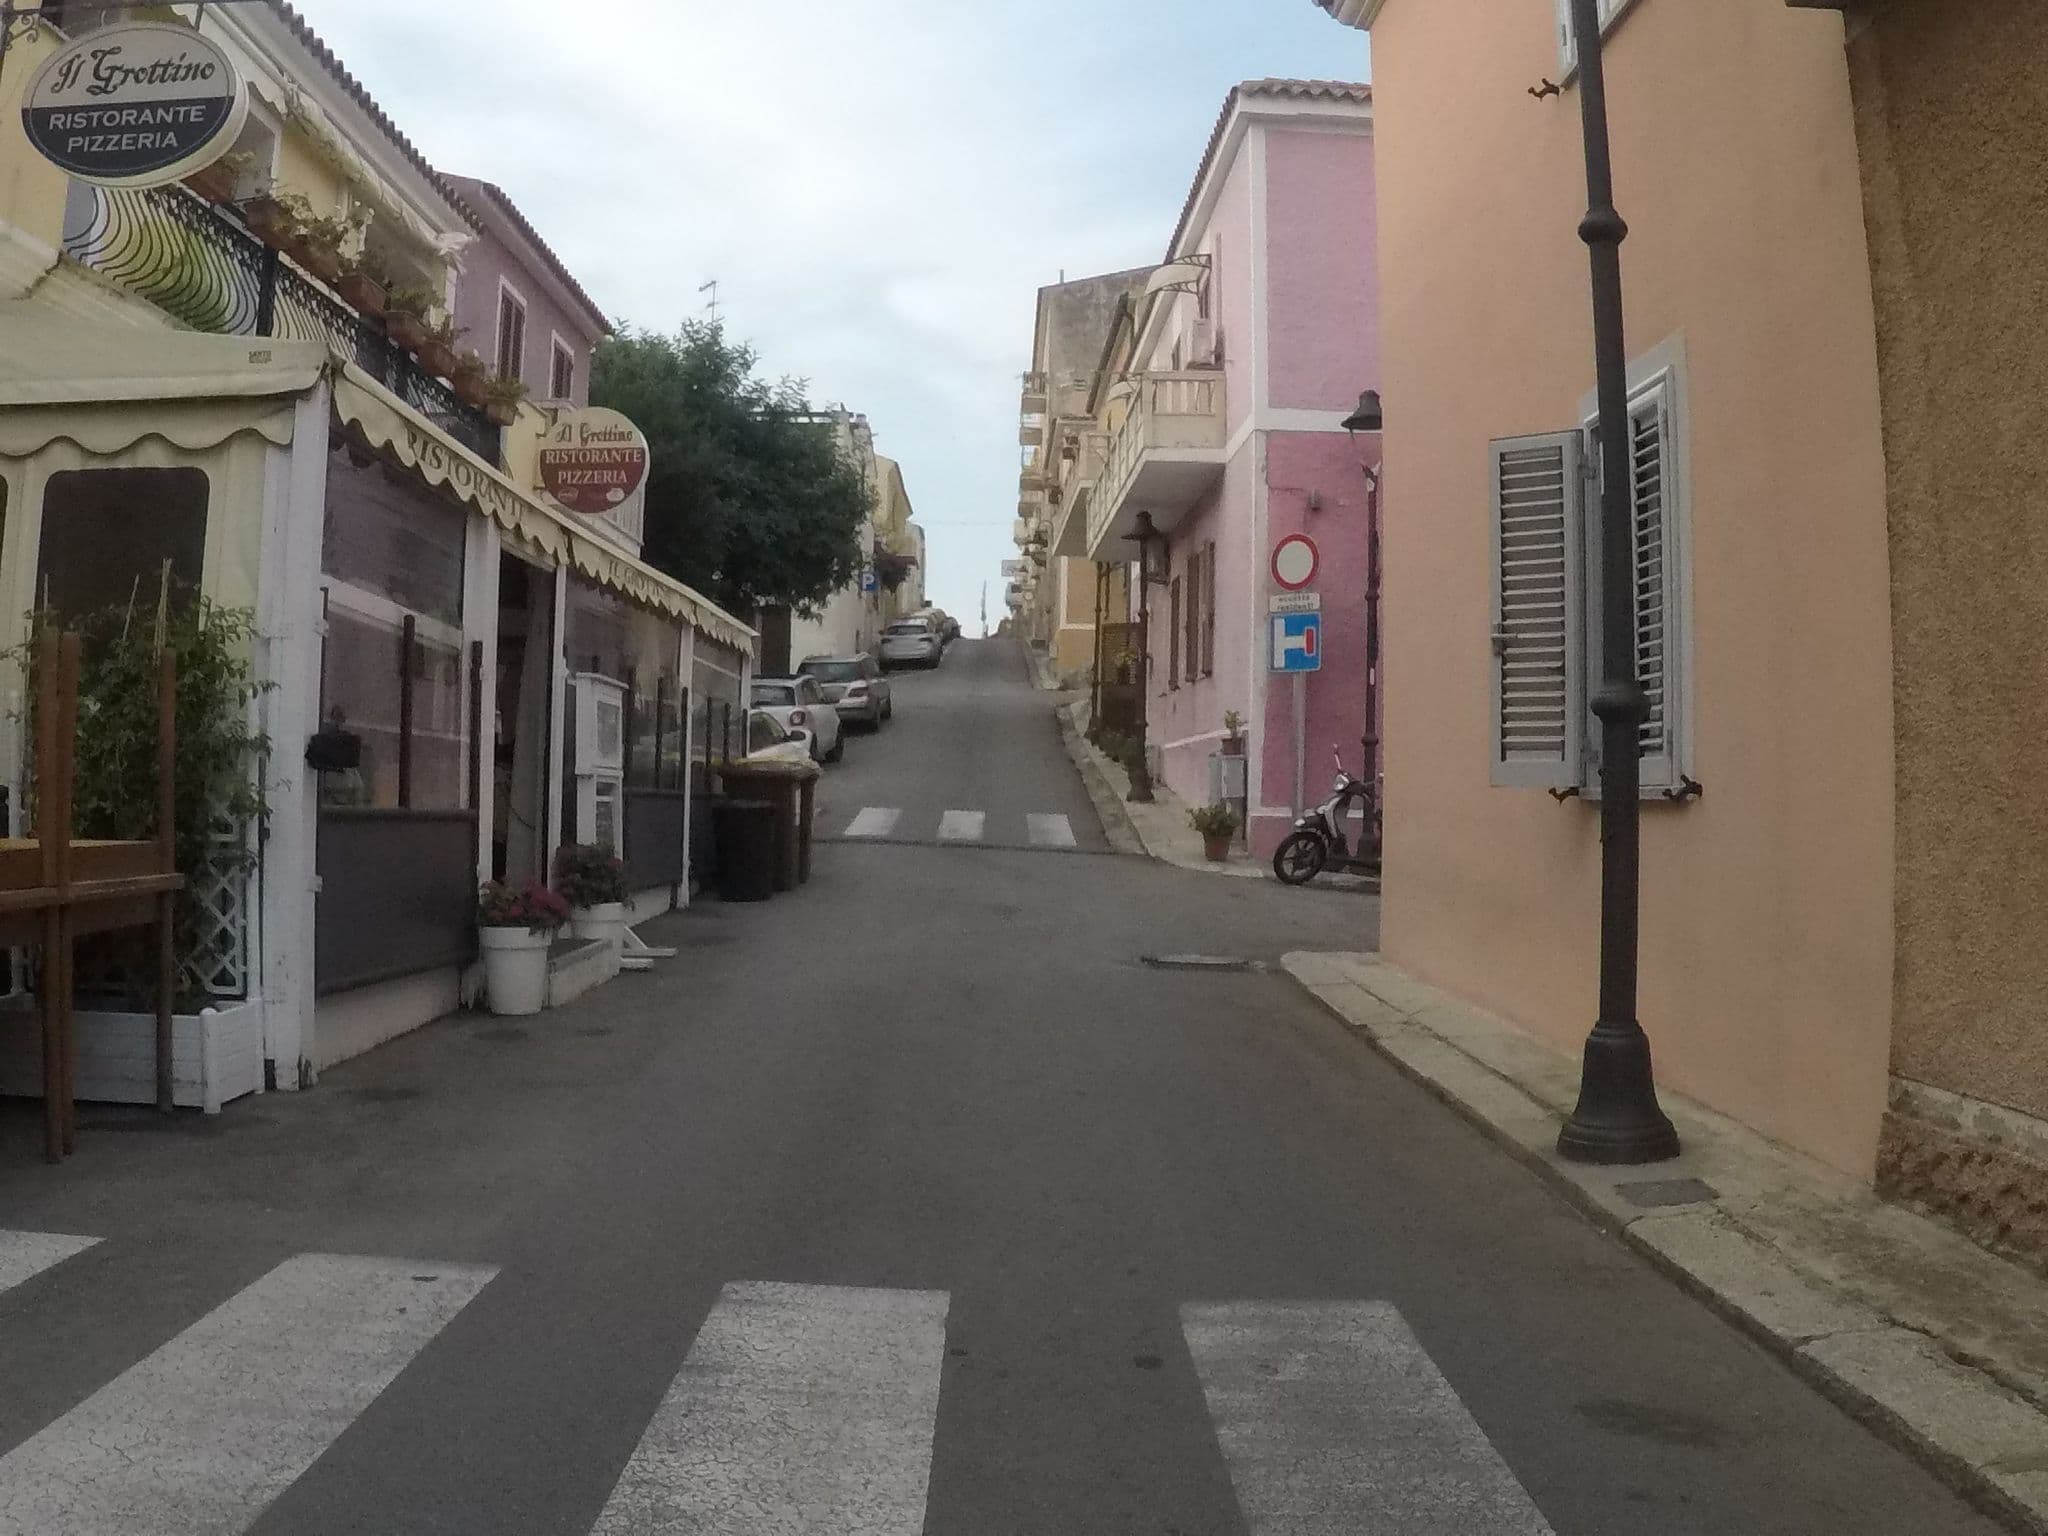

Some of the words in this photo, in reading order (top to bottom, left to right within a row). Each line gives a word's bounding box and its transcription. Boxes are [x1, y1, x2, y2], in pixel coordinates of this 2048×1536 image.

[51, 53, 85, 94] Il
[86, 46, 215, 96] Grottino
[49, 105, 206, 130] RISTORANTE
[67, 131, 178, 153] PIZZERIA
[545, 449, 641, 464] RISTORANTE
[558, 470, 628, 484] PIZZERIA
